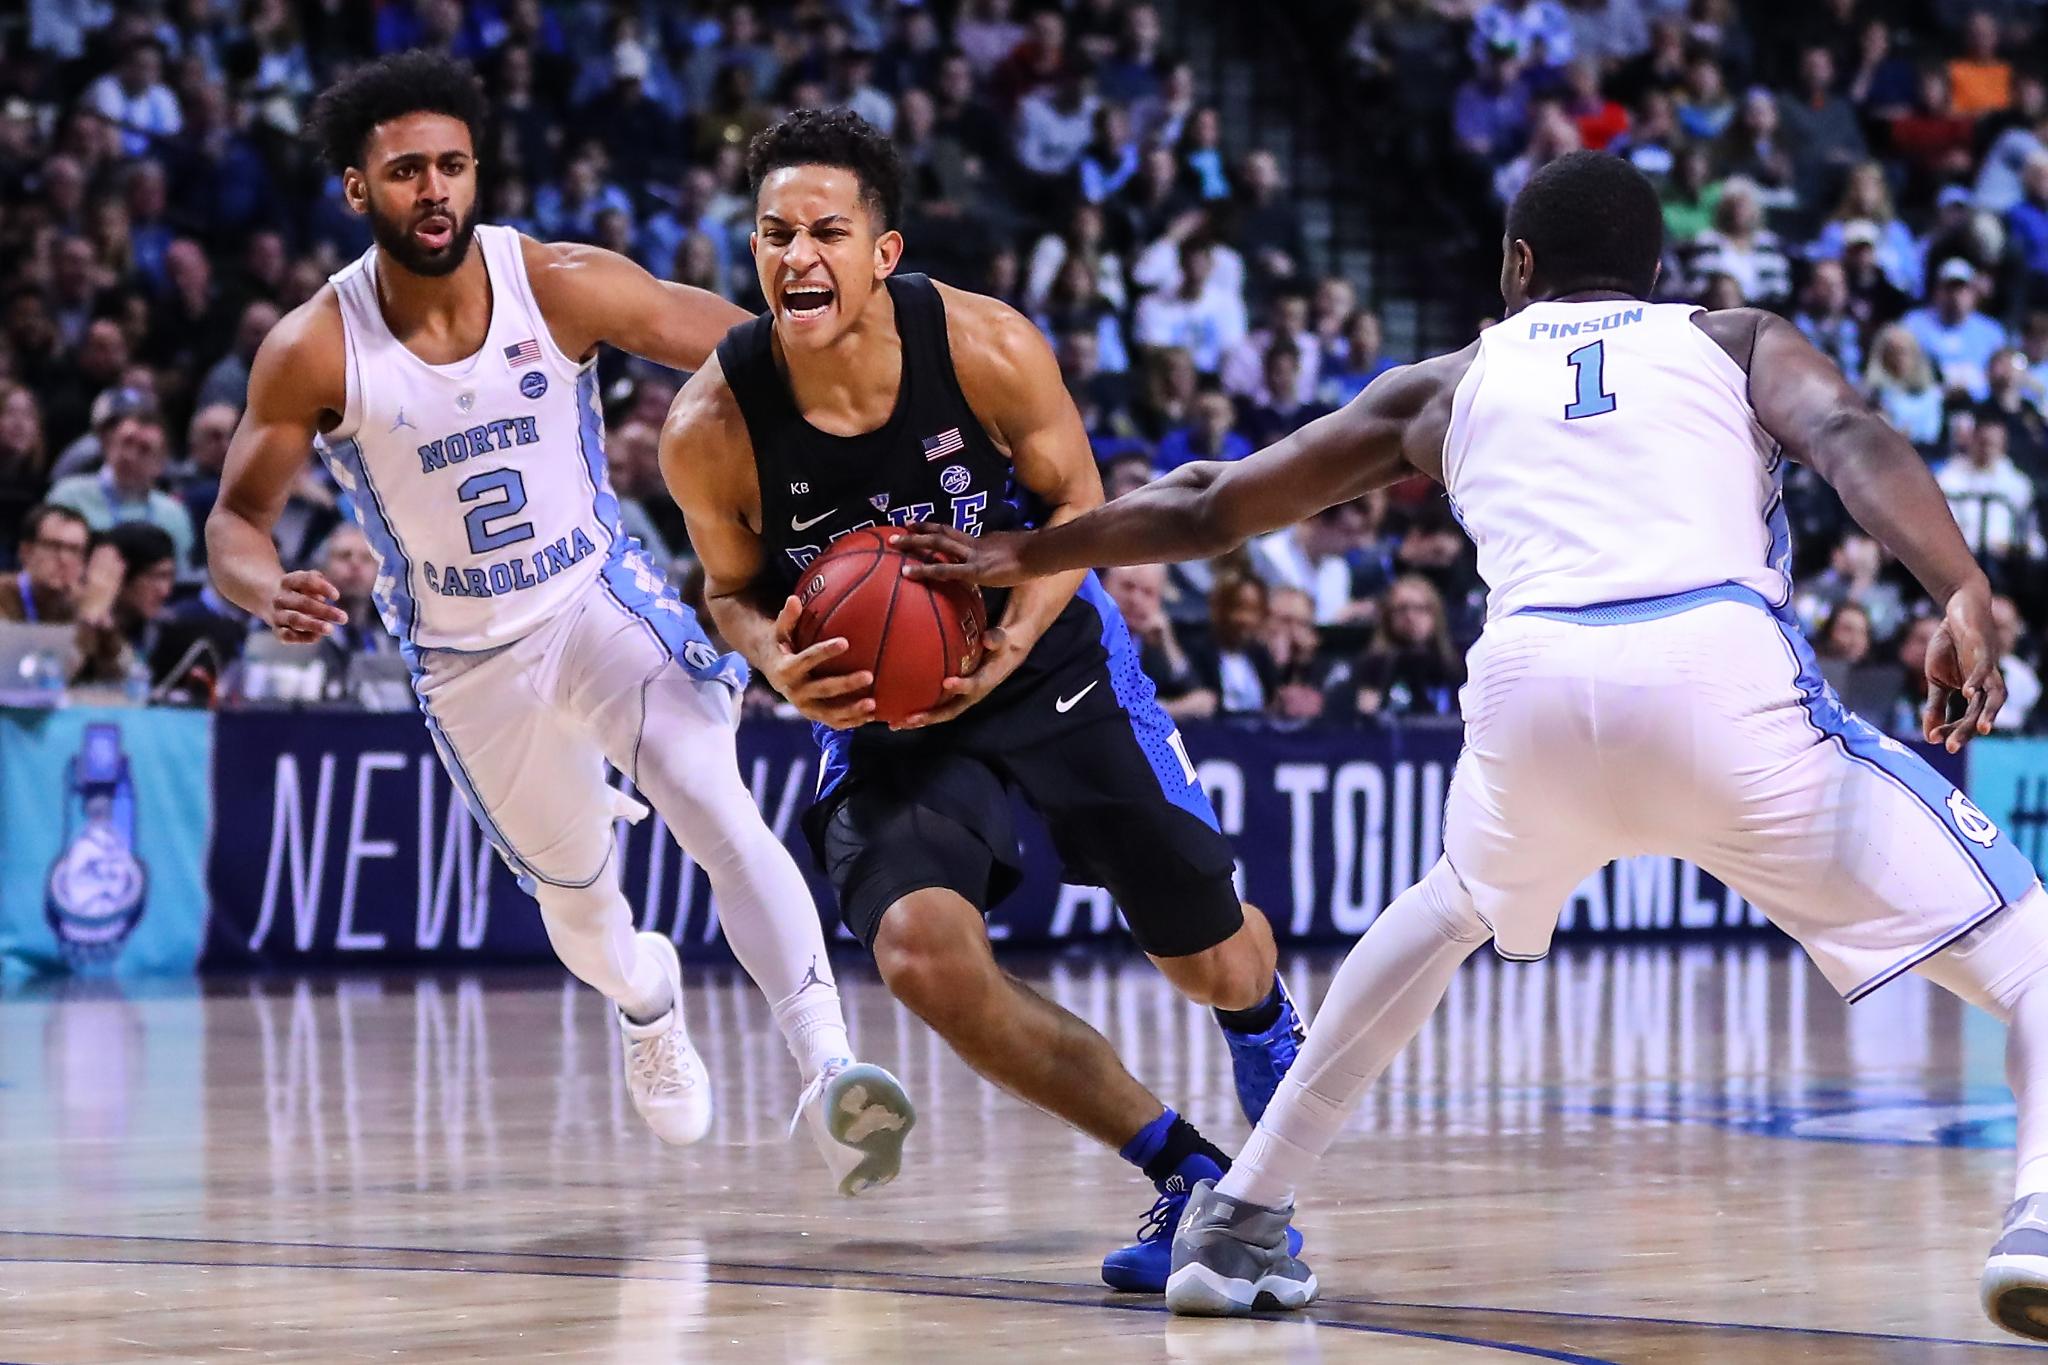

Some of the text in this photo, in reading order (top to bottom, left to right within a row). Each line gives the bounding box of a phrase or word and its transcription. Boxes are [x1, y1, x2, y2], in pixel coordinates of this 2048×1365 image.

[1529, 307, 1644, 340] PINSON
[1565, 339, 1617, 420] 1
[417, 416, 540, 474] NORTH
[457, 467, 535, 555] 2
[790, 481, 810, 495] KB
[423, 527, 596, 598] CAROLINA
[248, 752, 495, 952] NEW
